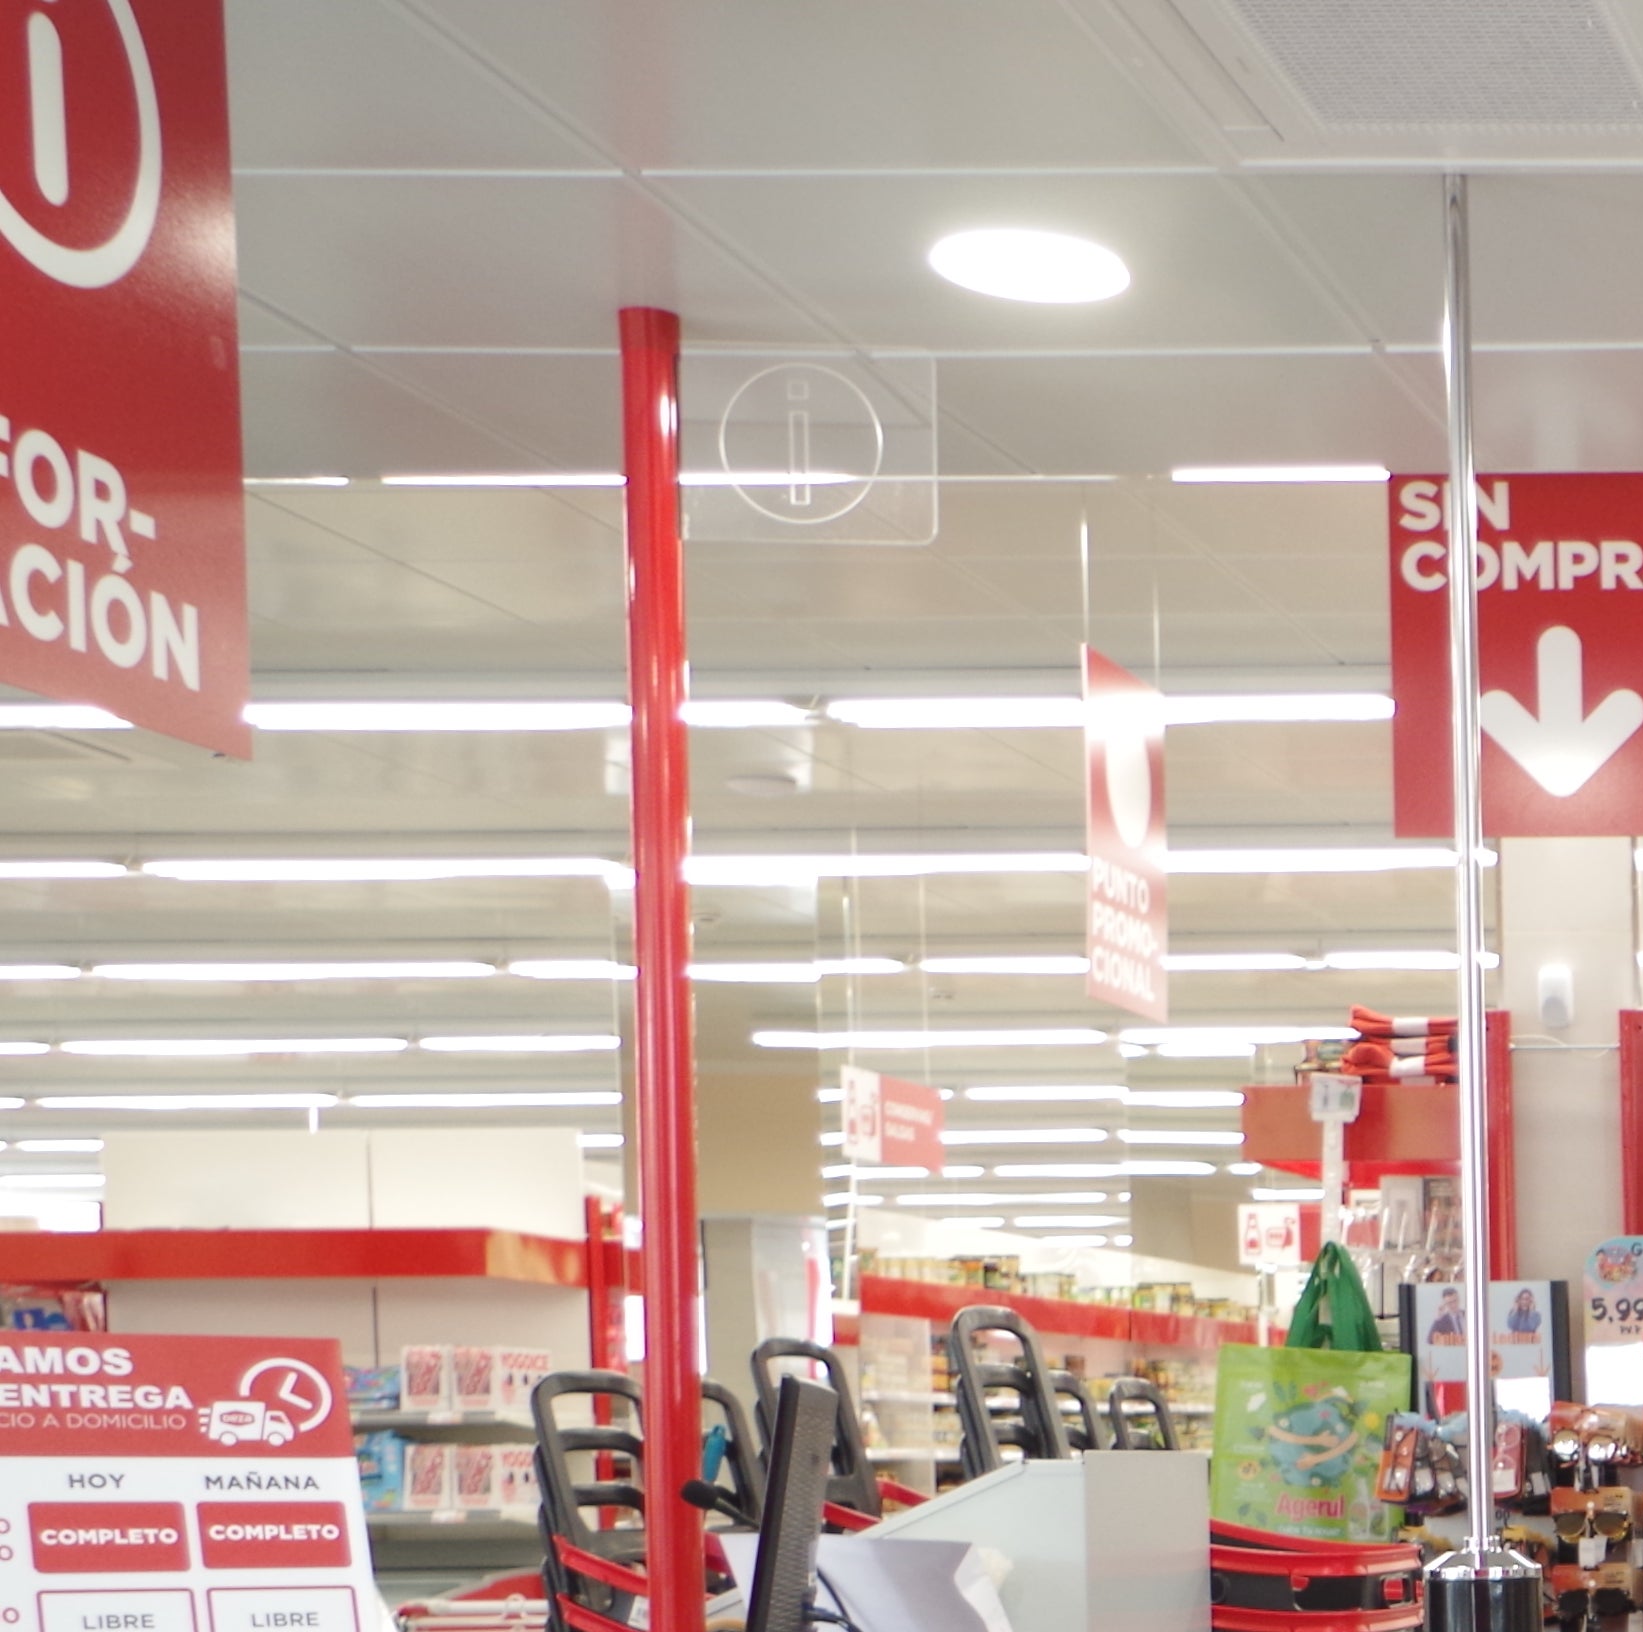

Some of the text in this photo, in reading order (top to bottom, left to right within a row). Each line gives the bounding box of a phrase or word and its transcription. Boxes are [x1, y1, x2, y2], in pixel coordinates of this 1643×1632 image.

[0, 414, 156, 556] OR-
[0, 543, 200, 692] CIÓN
[1092, 855, 1150, 914] PUNTO
[1092, 945, 1156, 1003] CIONAL
[0, 1346, 134, 1377] AMOS
[0, 1383, 193, 1410] ENTREGA
[43, 1412, 61, 1428] A
[66, 1412, 187, 1431] DOMICILIO
[68, 1471, 320, 1491] HOY MAÑANA
[1275, 1493, 1344, 1522] Agerul
[40, 1524, 340, 1545] COMPLETO COMPLETO
[82, 1611, 320, 1630] LIBRE LIBRE
